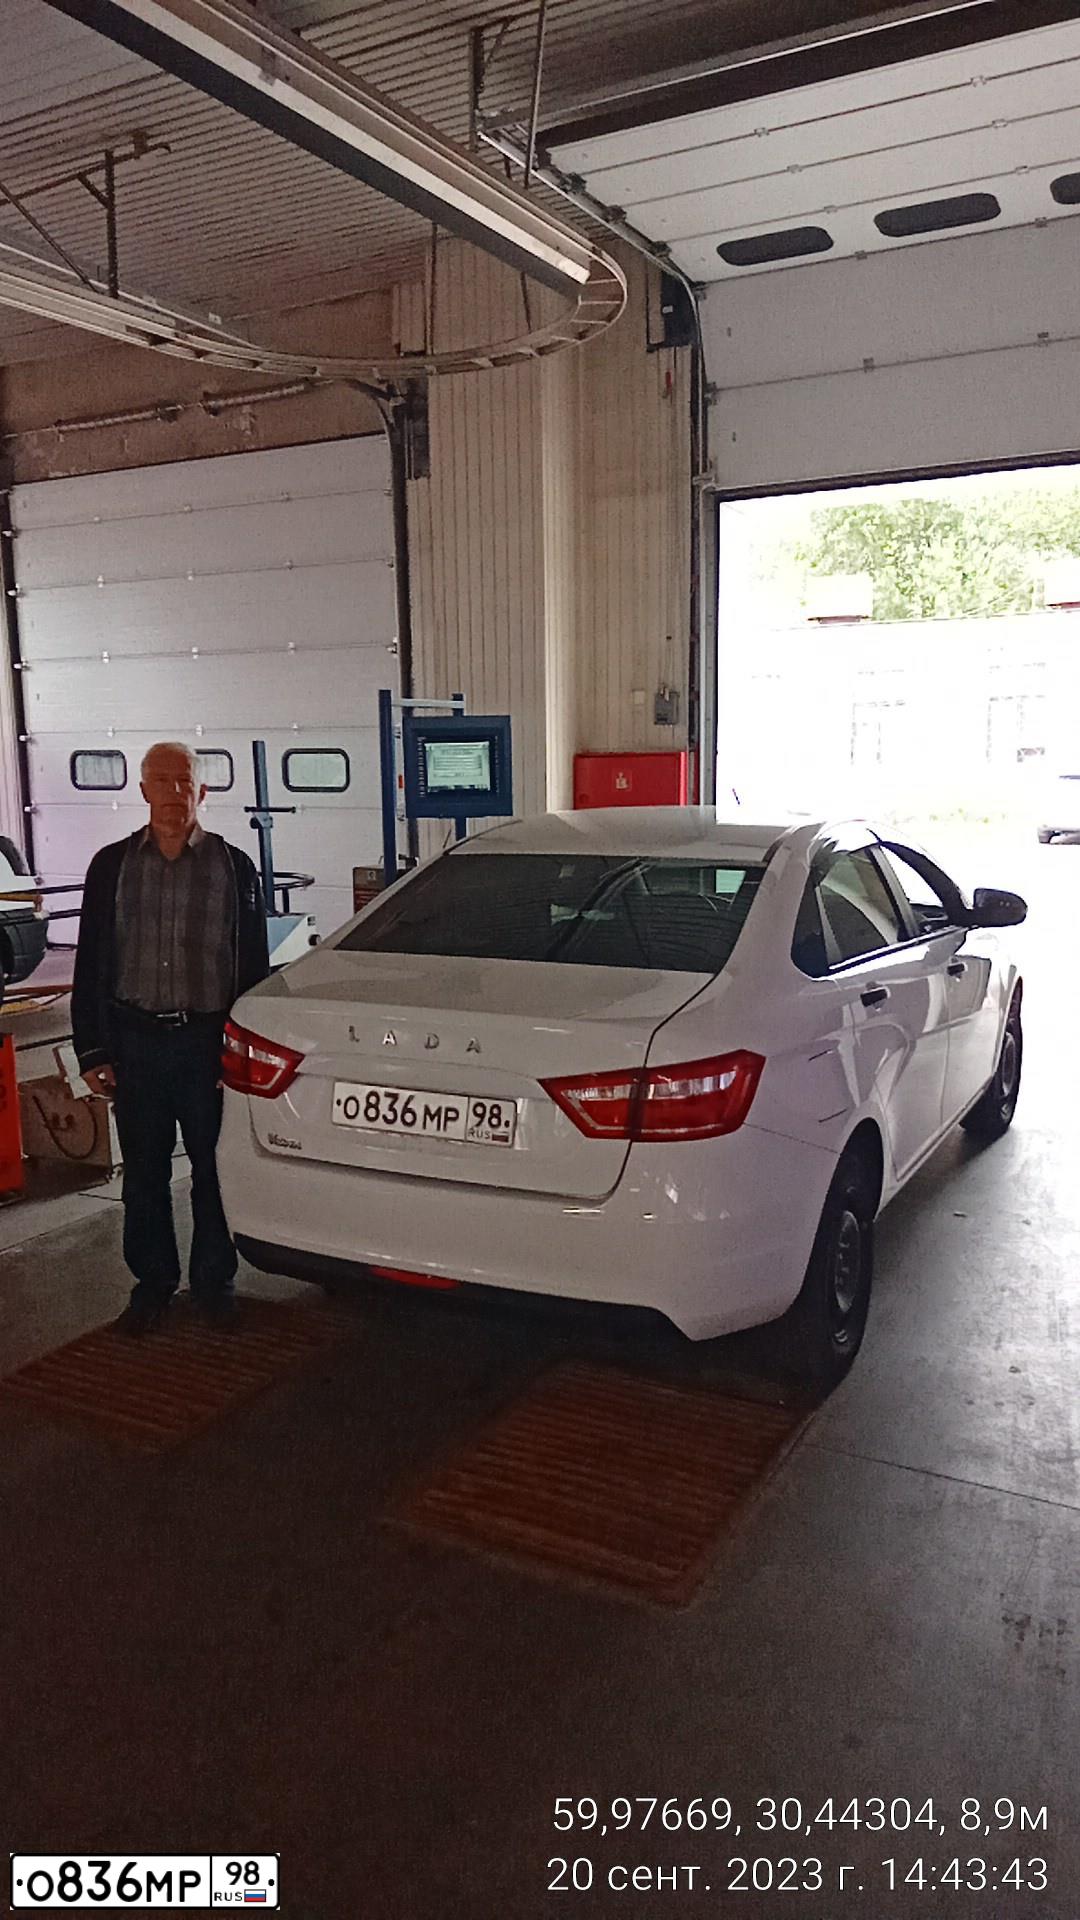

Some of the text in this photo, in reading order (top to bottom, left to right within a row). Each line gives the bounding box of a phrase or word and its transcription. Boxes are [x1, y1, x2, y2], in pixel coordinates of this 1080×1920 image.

[348, 1025, 482, 1054] LADA
[472, 1102, 502, 1129] 98
[468, 1128, 491, 1140] RUS
